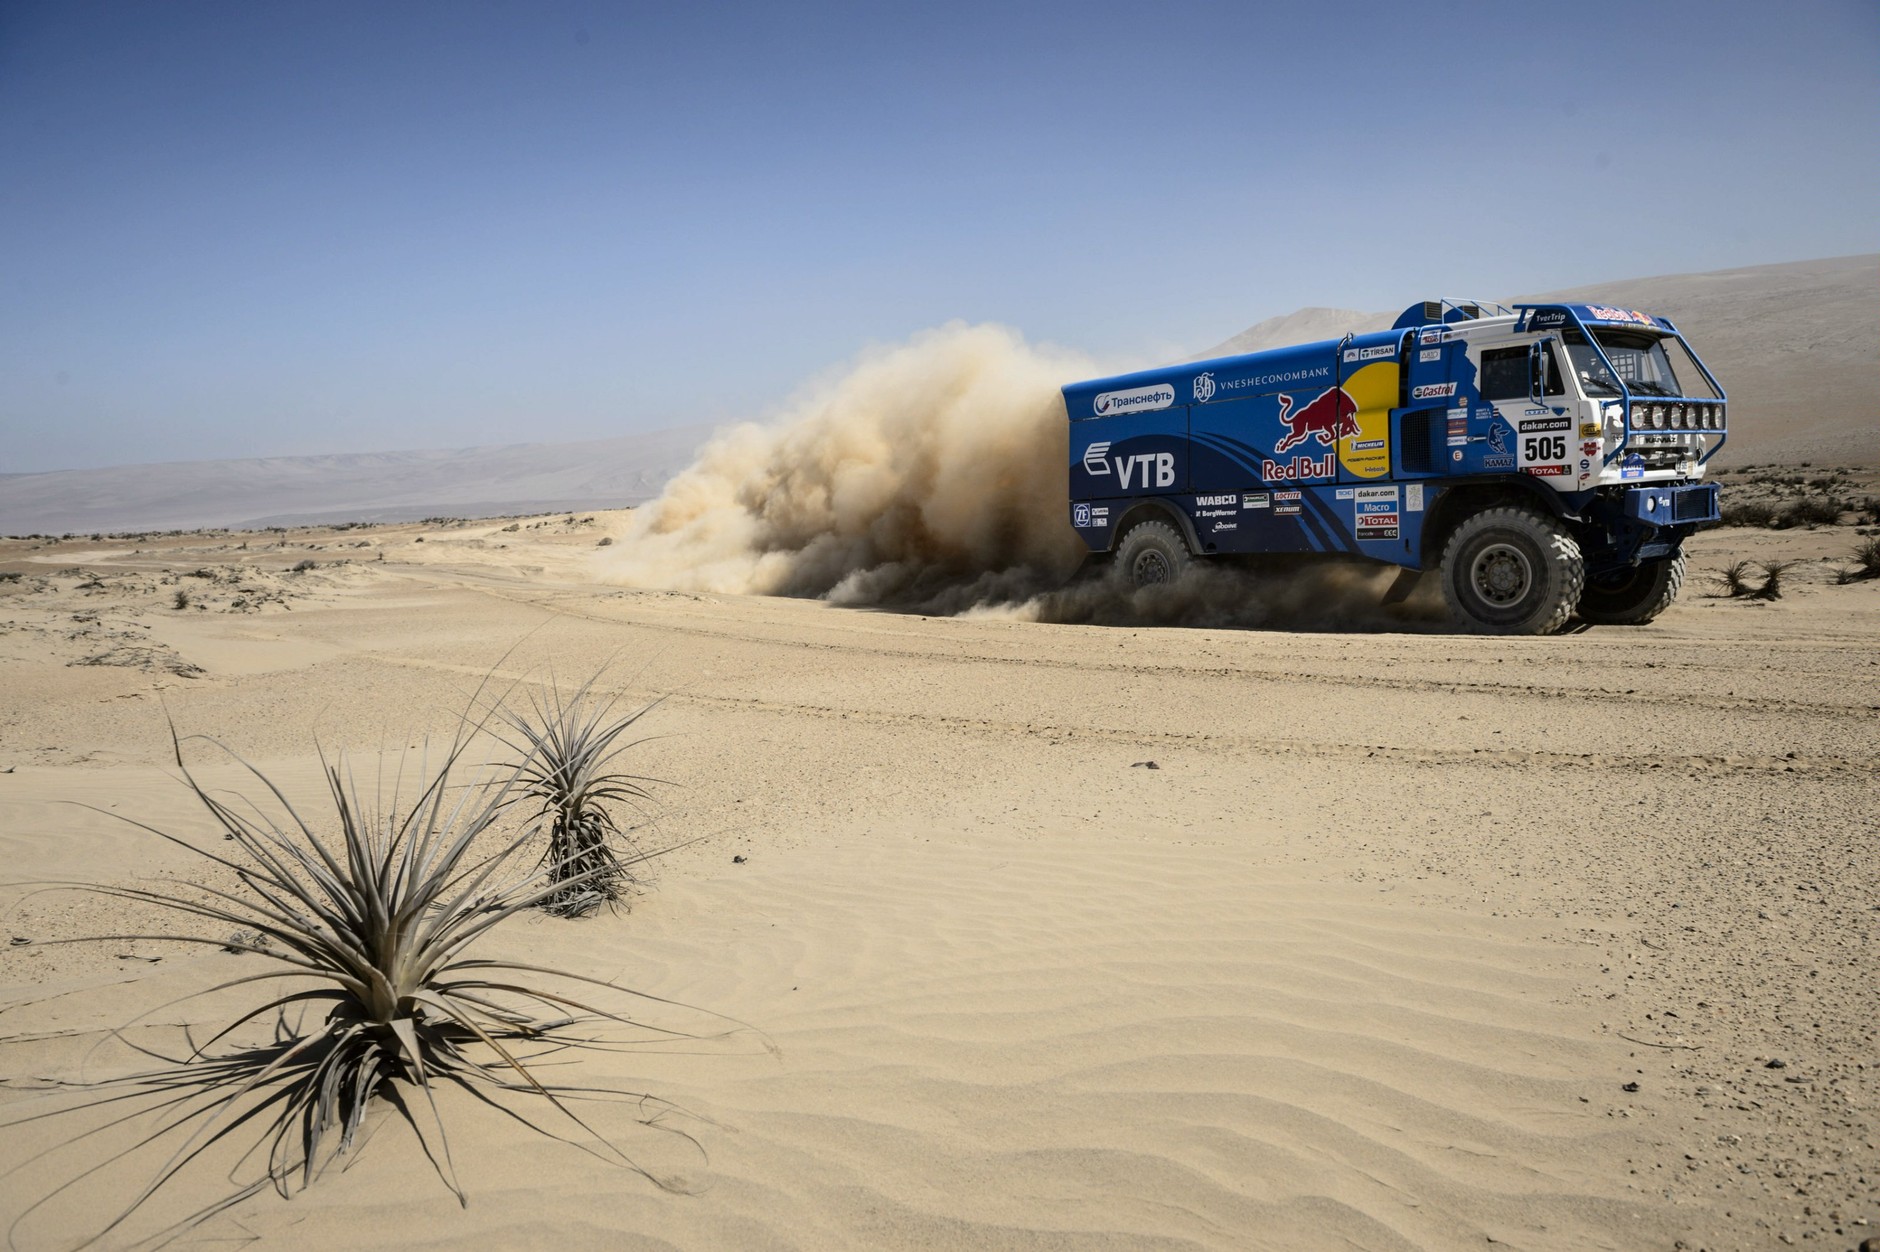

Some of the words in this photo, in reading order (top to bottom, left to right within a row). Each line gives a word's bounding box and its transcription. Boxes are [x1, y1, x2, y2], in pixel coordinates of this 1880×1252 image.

[1536, 312, 1566, 322] TverTrip
[1220, 366, 1329, 390] VNESHECONOMBANK
[1422, 385, 1454, 397] Castrol
[1111, 391, 1172, 408] Транснефть
[1521, 420, 1568, 431] dakar.com
[1357, 440, 1384, 449] MICHELIN
[1524, 436, 1566, 461] 505
[1262, 456, 1298, 481] Red
[1299, 453, 1336, 479] Bull
[1484, 457, 1514, 468] KAMAZ
[1114, 452, 1175, 490] VTB
[1275, 492, 1300, 500] LOCTITE
[1358, 490, 1395, 498] dakar.com
[1196, 494, 1237, 507] WABCO
[1364, 503, 1390, 512] Macro
[1202, 510, 1237, 518] BorgWarner
[1366, 516, 1397, 525] TOTAL
